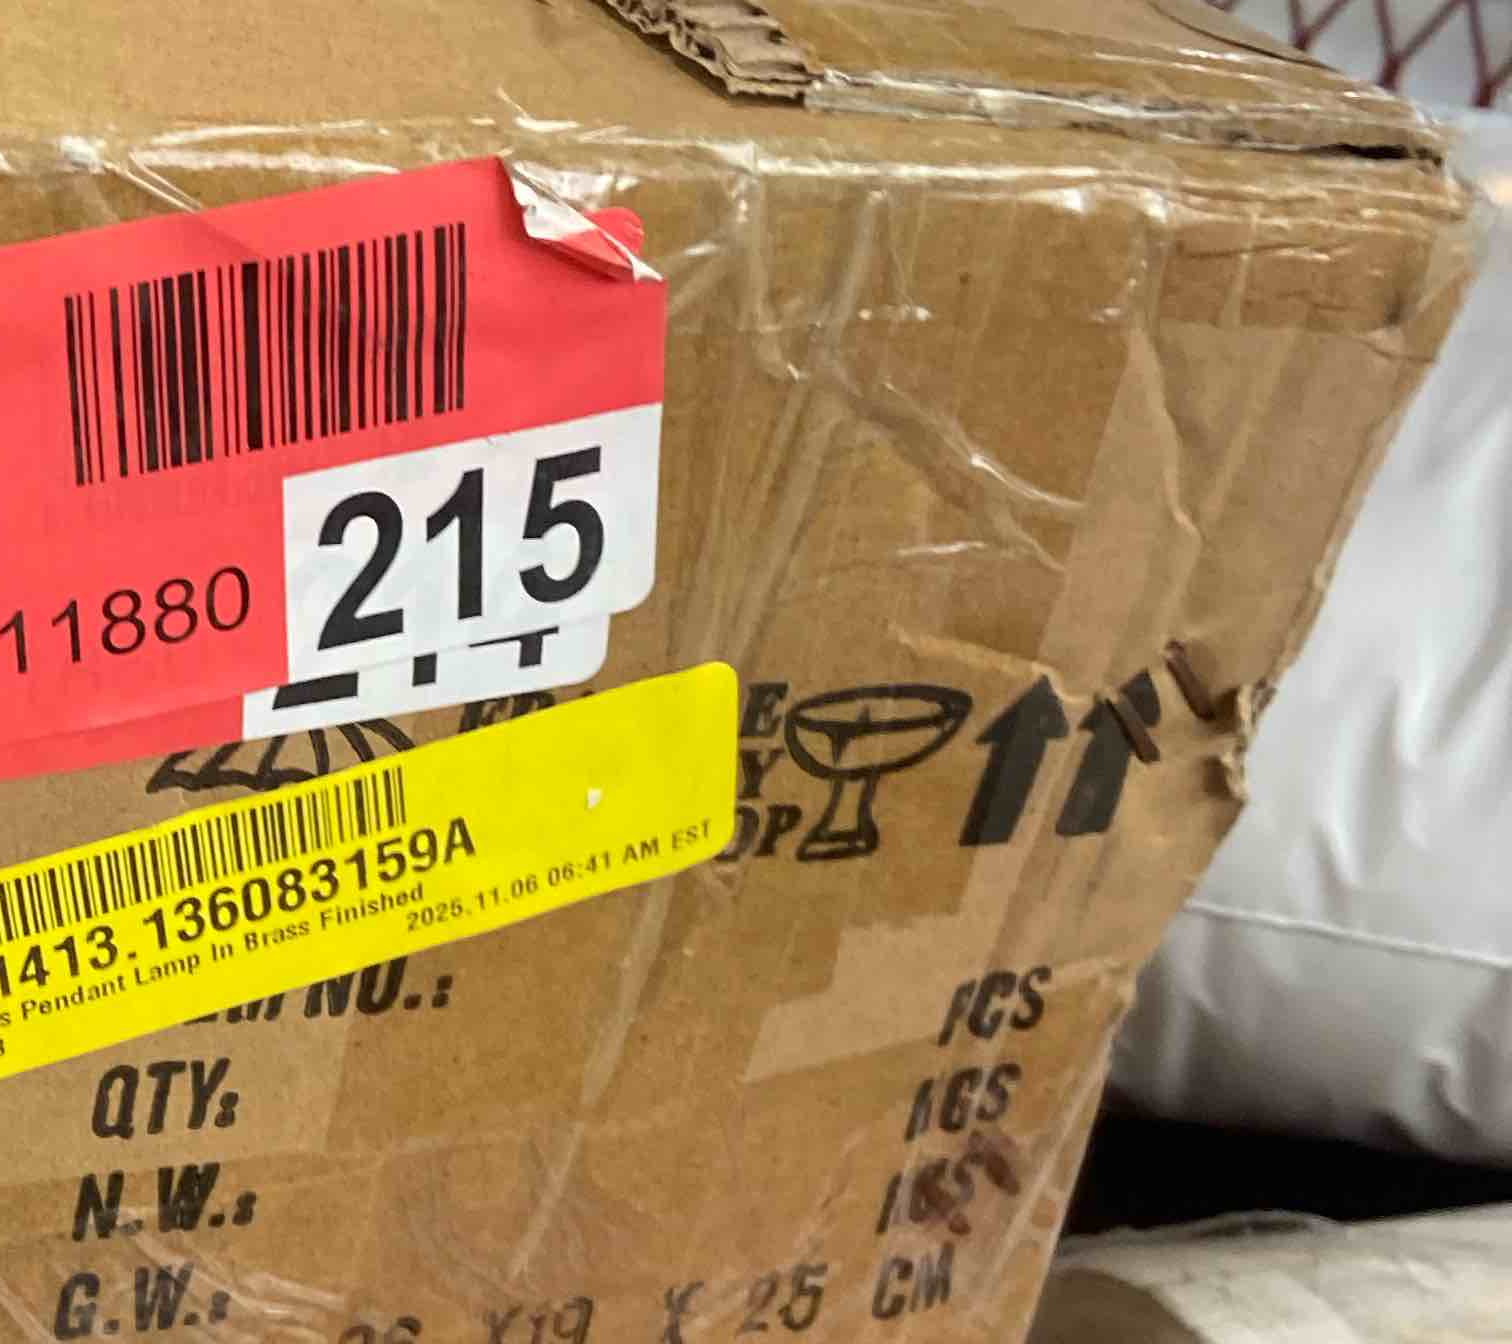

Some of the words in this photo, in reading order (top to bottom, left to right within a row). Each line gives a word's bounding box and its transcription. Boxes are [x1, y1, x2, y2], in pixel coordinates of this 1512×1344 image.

[317, 446, 605, 652] 215
[406, 873, 539, 933] 2025.11.06
[548, 850, 612, 888] 06:41
[622, 837, 661, 865] AM
[672, 818, 713, 852] EST
[21, 974, 127, 1022] Pendant
[133, 953, 200, 987] Lamp
[211, 940, 234, 963] In
[243, 919, 311, 952] Brass
[320, 882, 424, 931] Finished
[91, 1057, 239, 1140] QTY:
[736, 1262, 829, 1337] 25
[871, 1241, 955, 1320] CM
